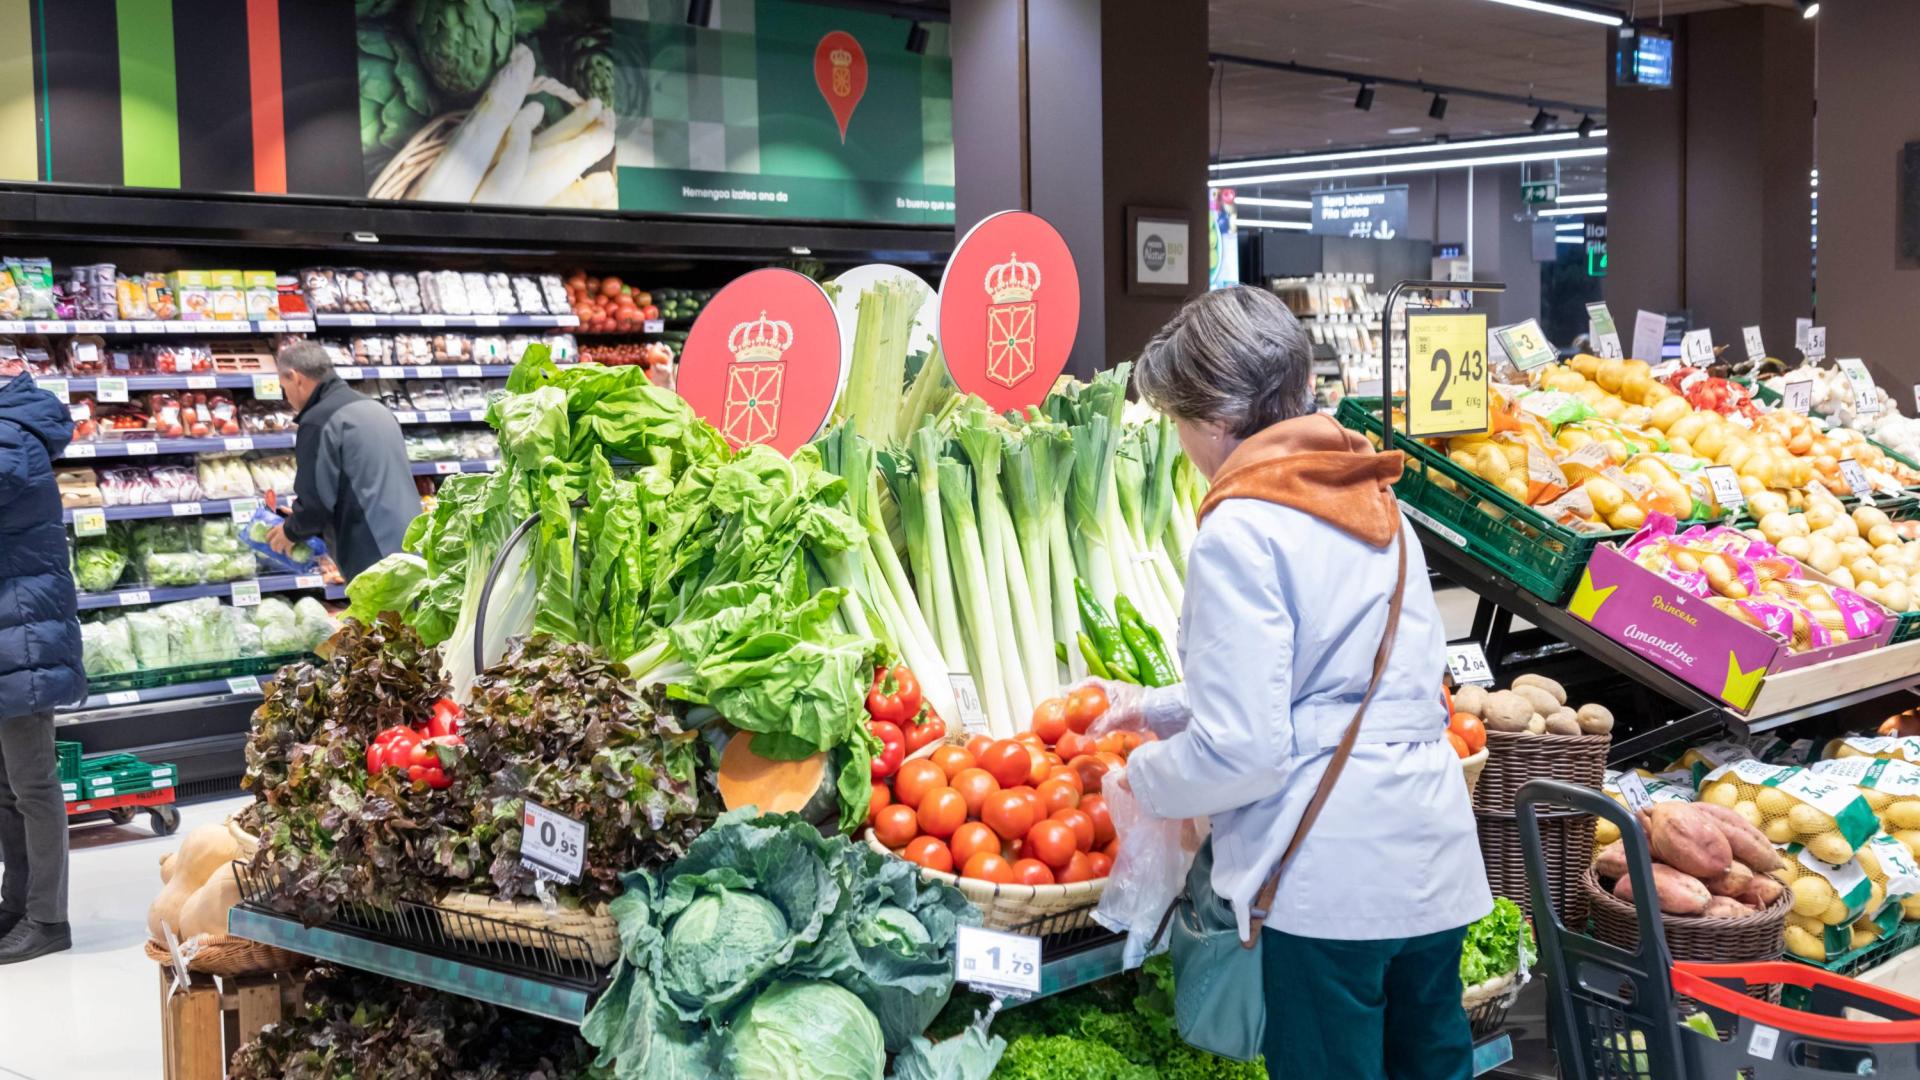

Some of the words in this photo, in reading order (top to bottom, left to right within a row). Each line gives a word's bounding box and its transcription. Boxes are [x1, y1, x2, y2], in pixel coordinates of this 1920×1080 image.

[682, 186, 730, 201] Hemengoa
[1431, 348, 1483, 412] 2,43
[1652, 595, 1698, 627] Princesa
[1623, 624, 1694, 667] Amandine
[540, 821, 578, 858] 0,95
